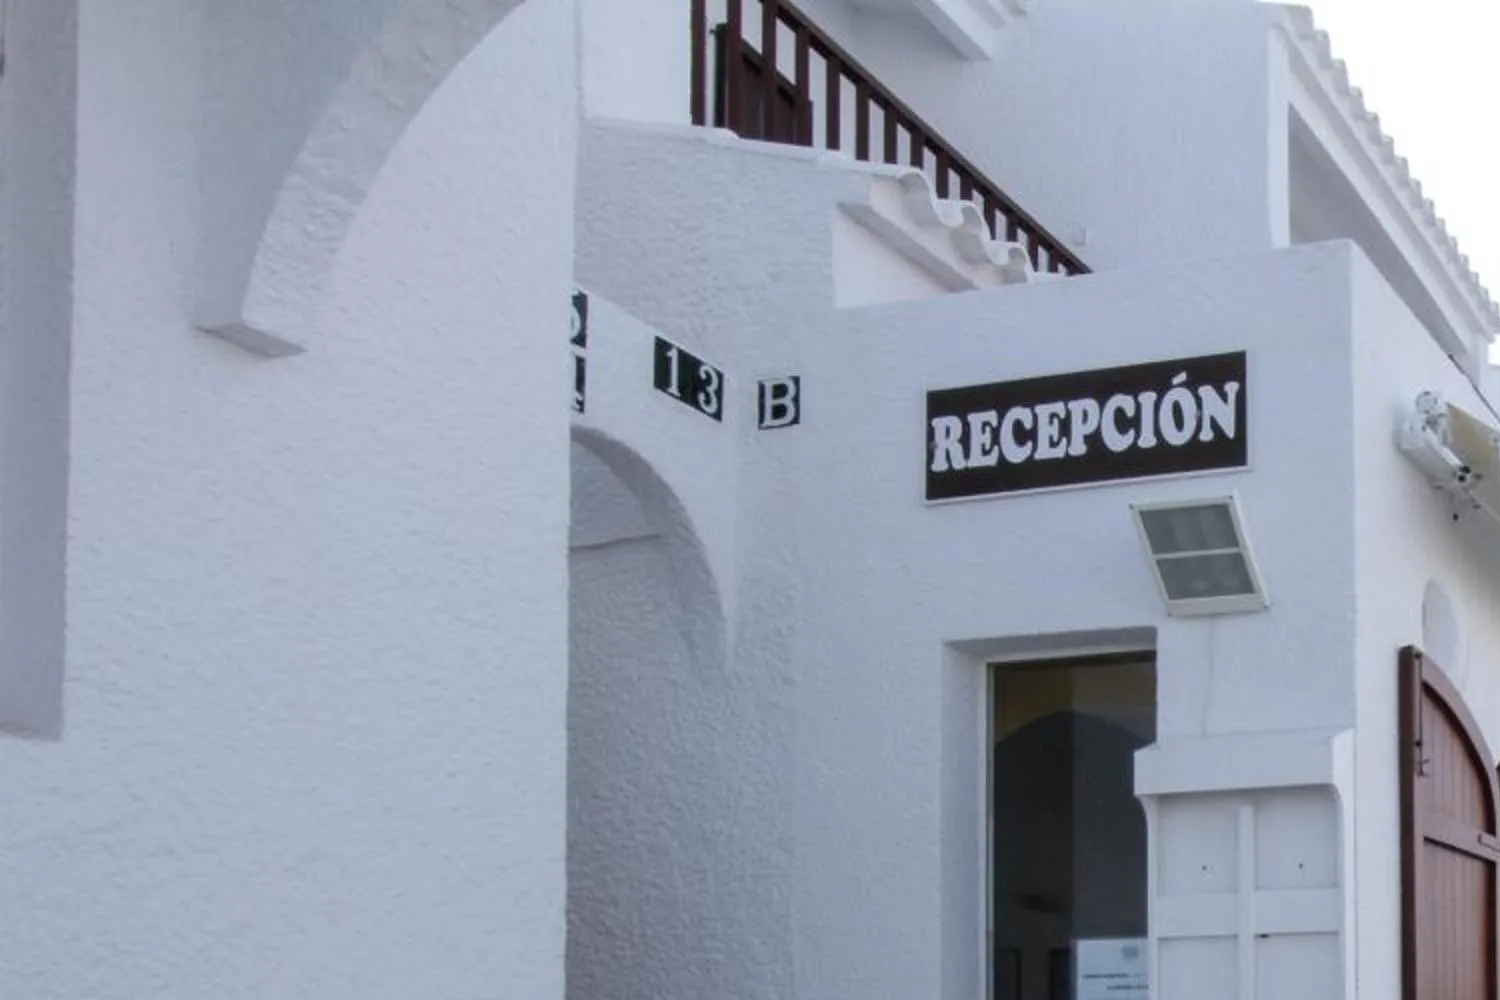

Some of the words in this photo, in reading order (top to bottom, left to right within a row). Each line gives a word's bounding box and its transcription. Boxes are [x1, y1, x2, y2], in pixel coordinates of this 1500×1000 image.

[666, 347, 719, 415] 13
[761, 378, 796, 428] B
[931, 372, 1240, 472] RECEPCIÓN
